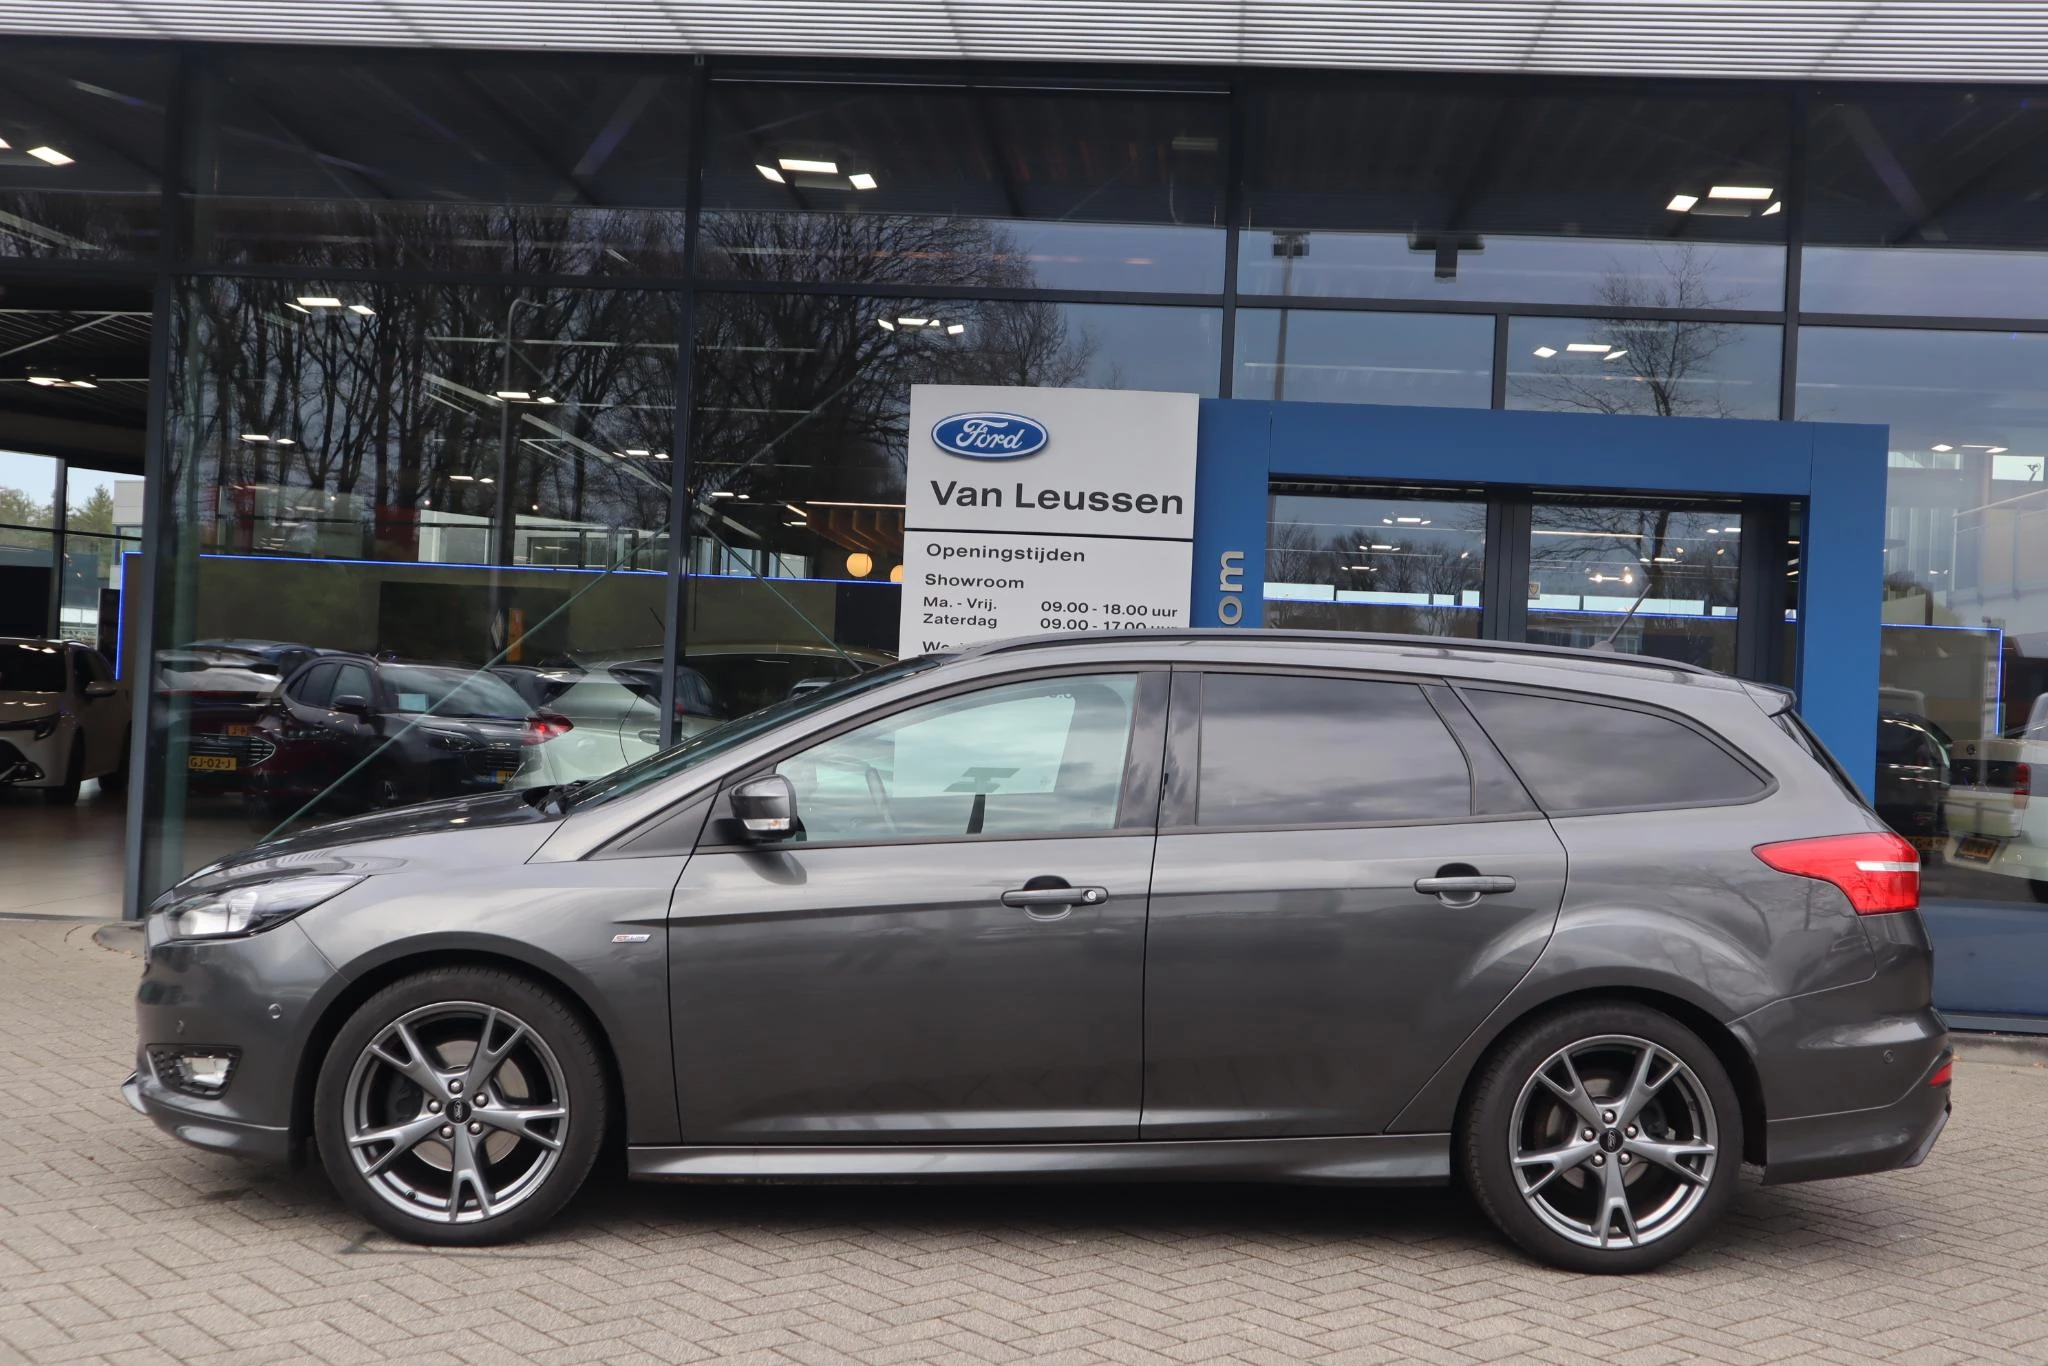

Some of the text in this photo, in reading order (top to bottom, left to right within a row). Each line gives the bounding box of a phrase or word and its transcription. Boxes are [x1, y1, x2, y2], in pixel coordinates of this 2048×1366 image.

[955, 419, 1025, 449] Ford
[930, 480, 1184, 515] Van Leussen
[926, 543, 1086, 563] Openingstijden
[925, 573, 1025, 589] Showroom
[923, 596, 953, 608] Ma.
[966, 597, 998, 612] Vrij.
[1041, 600, 1089, 614] 09.00
[1103, 603, 1148, 616] 18.00
[1151, 607, 1178, 618] uur
[922, 613, 998, 629] Zaterdag
[1040, 618, 1089, 631] 09.00
